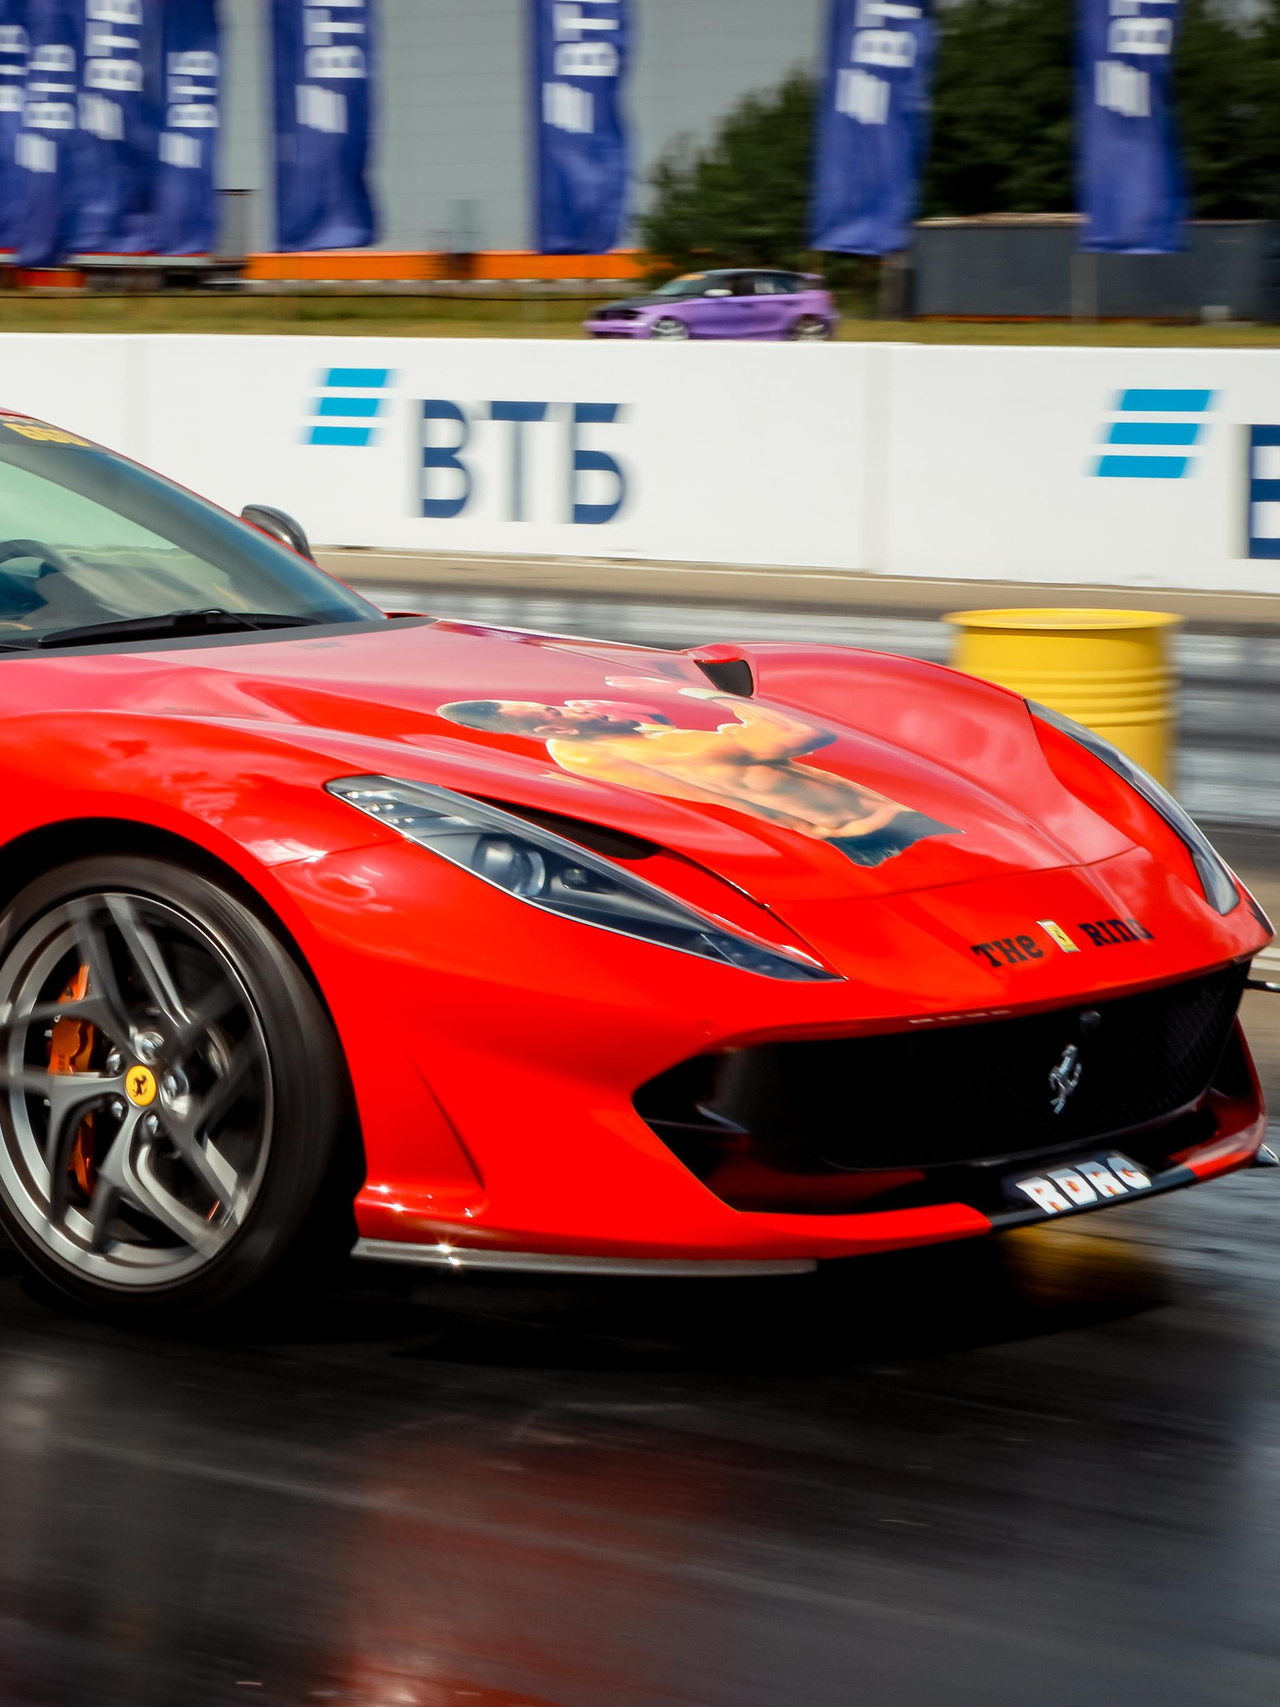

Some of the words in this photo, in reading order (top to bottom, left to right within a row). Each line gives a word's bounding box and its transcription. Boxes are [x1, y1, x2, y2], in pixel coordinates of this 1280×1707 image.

[303, 0, 366, 78] ВТ
[553, 0, 619, 76] ВТ
[410, 399, 631, 524] ВТБ
[1015, 1156, 1152, 1214] RDRC
